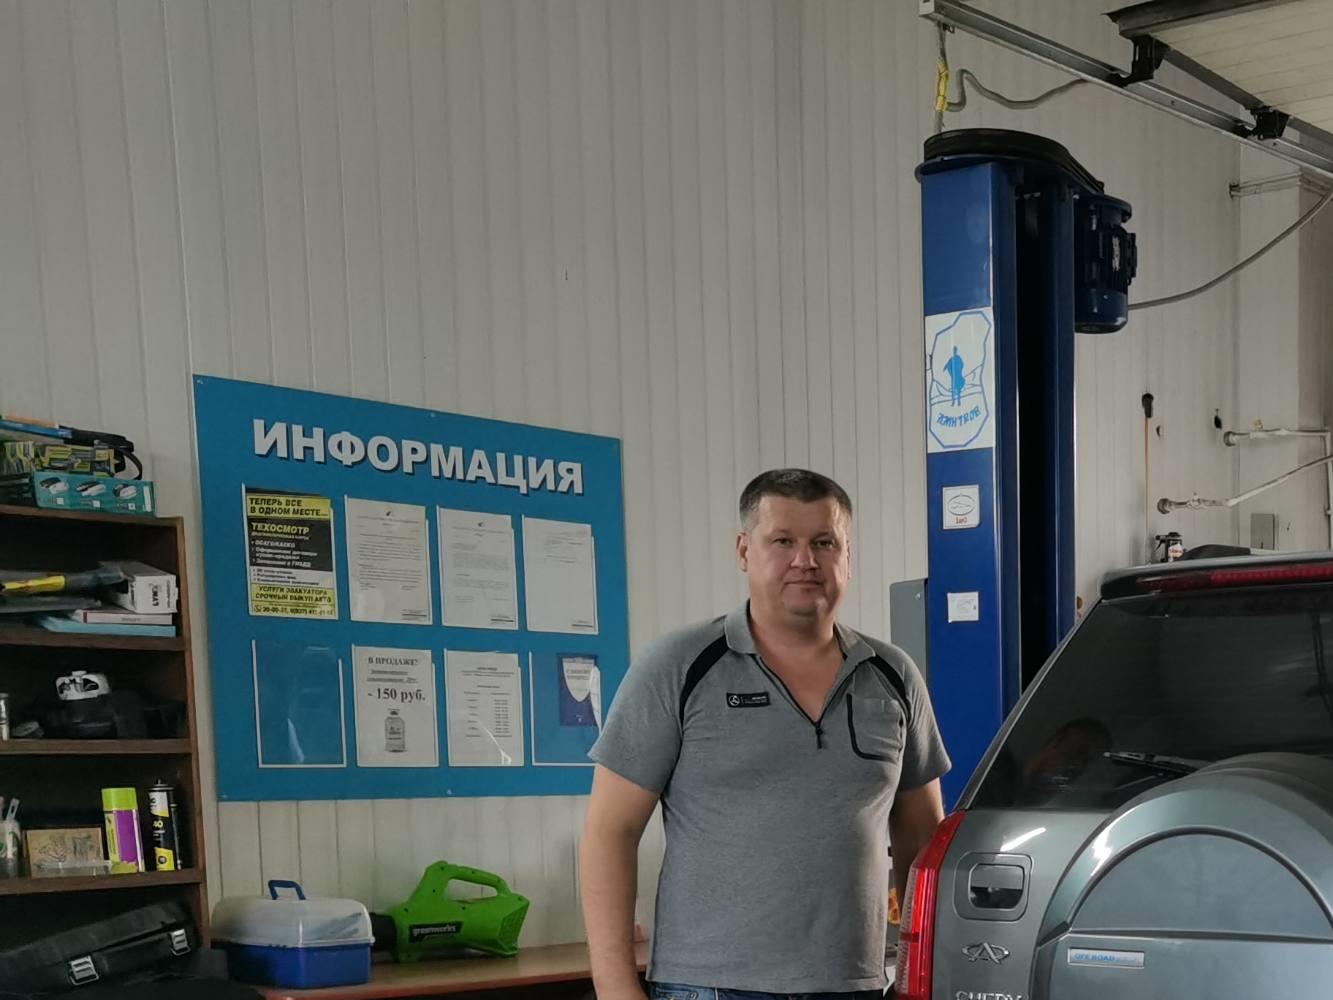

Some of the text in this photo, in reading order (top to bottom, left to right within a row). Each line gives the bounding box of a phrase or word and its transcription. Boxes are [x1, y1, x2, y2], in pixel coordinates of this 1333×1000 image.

[253, 418, 584, 495] ИНФОРМАЦИЯ
[248, 497, 302, 507] ТЕПЕРЬ ВСЕ
[258, 507, 291, 515] ОДНОМ
[251, 522, 310, 535] ТЕХОСМОТР
[377, 688, 398, 700] 150
[400, 689, 426, 703] руб.
